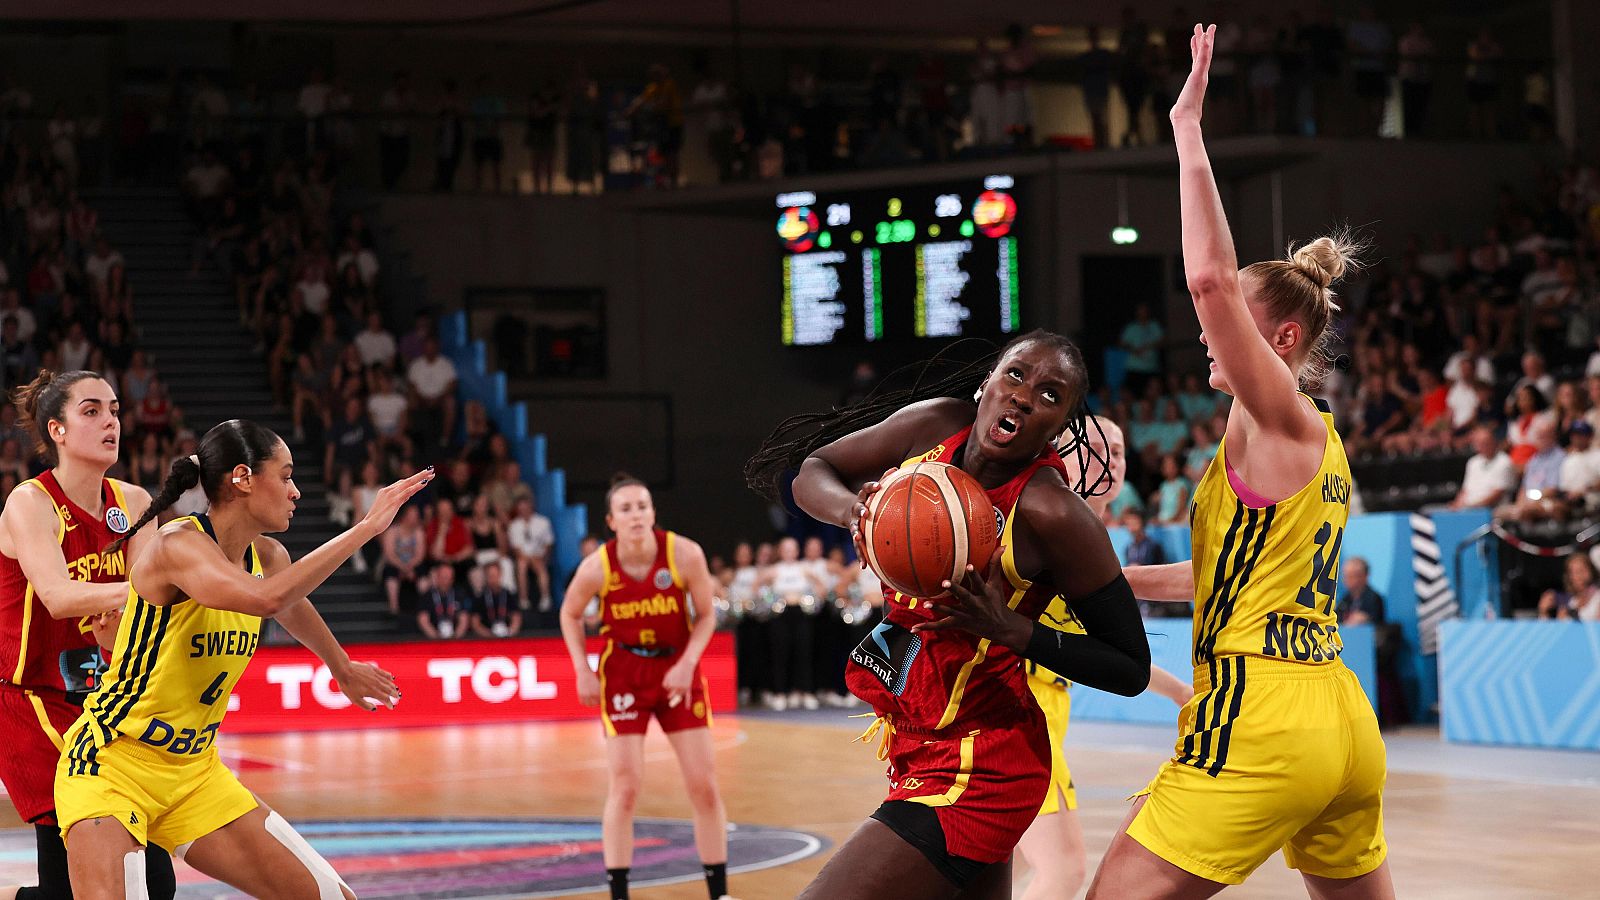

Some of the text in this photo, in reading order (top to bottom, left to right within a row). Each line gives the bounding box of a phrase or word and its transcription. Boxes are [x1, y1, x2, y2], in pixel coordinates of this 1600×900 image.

[1295, 521, 1344, 616] 14
[610, 592, 679, 620] ESPAÑA
[200, 671, 228, 706] 4
[427, 655, 558, 704] TCL
